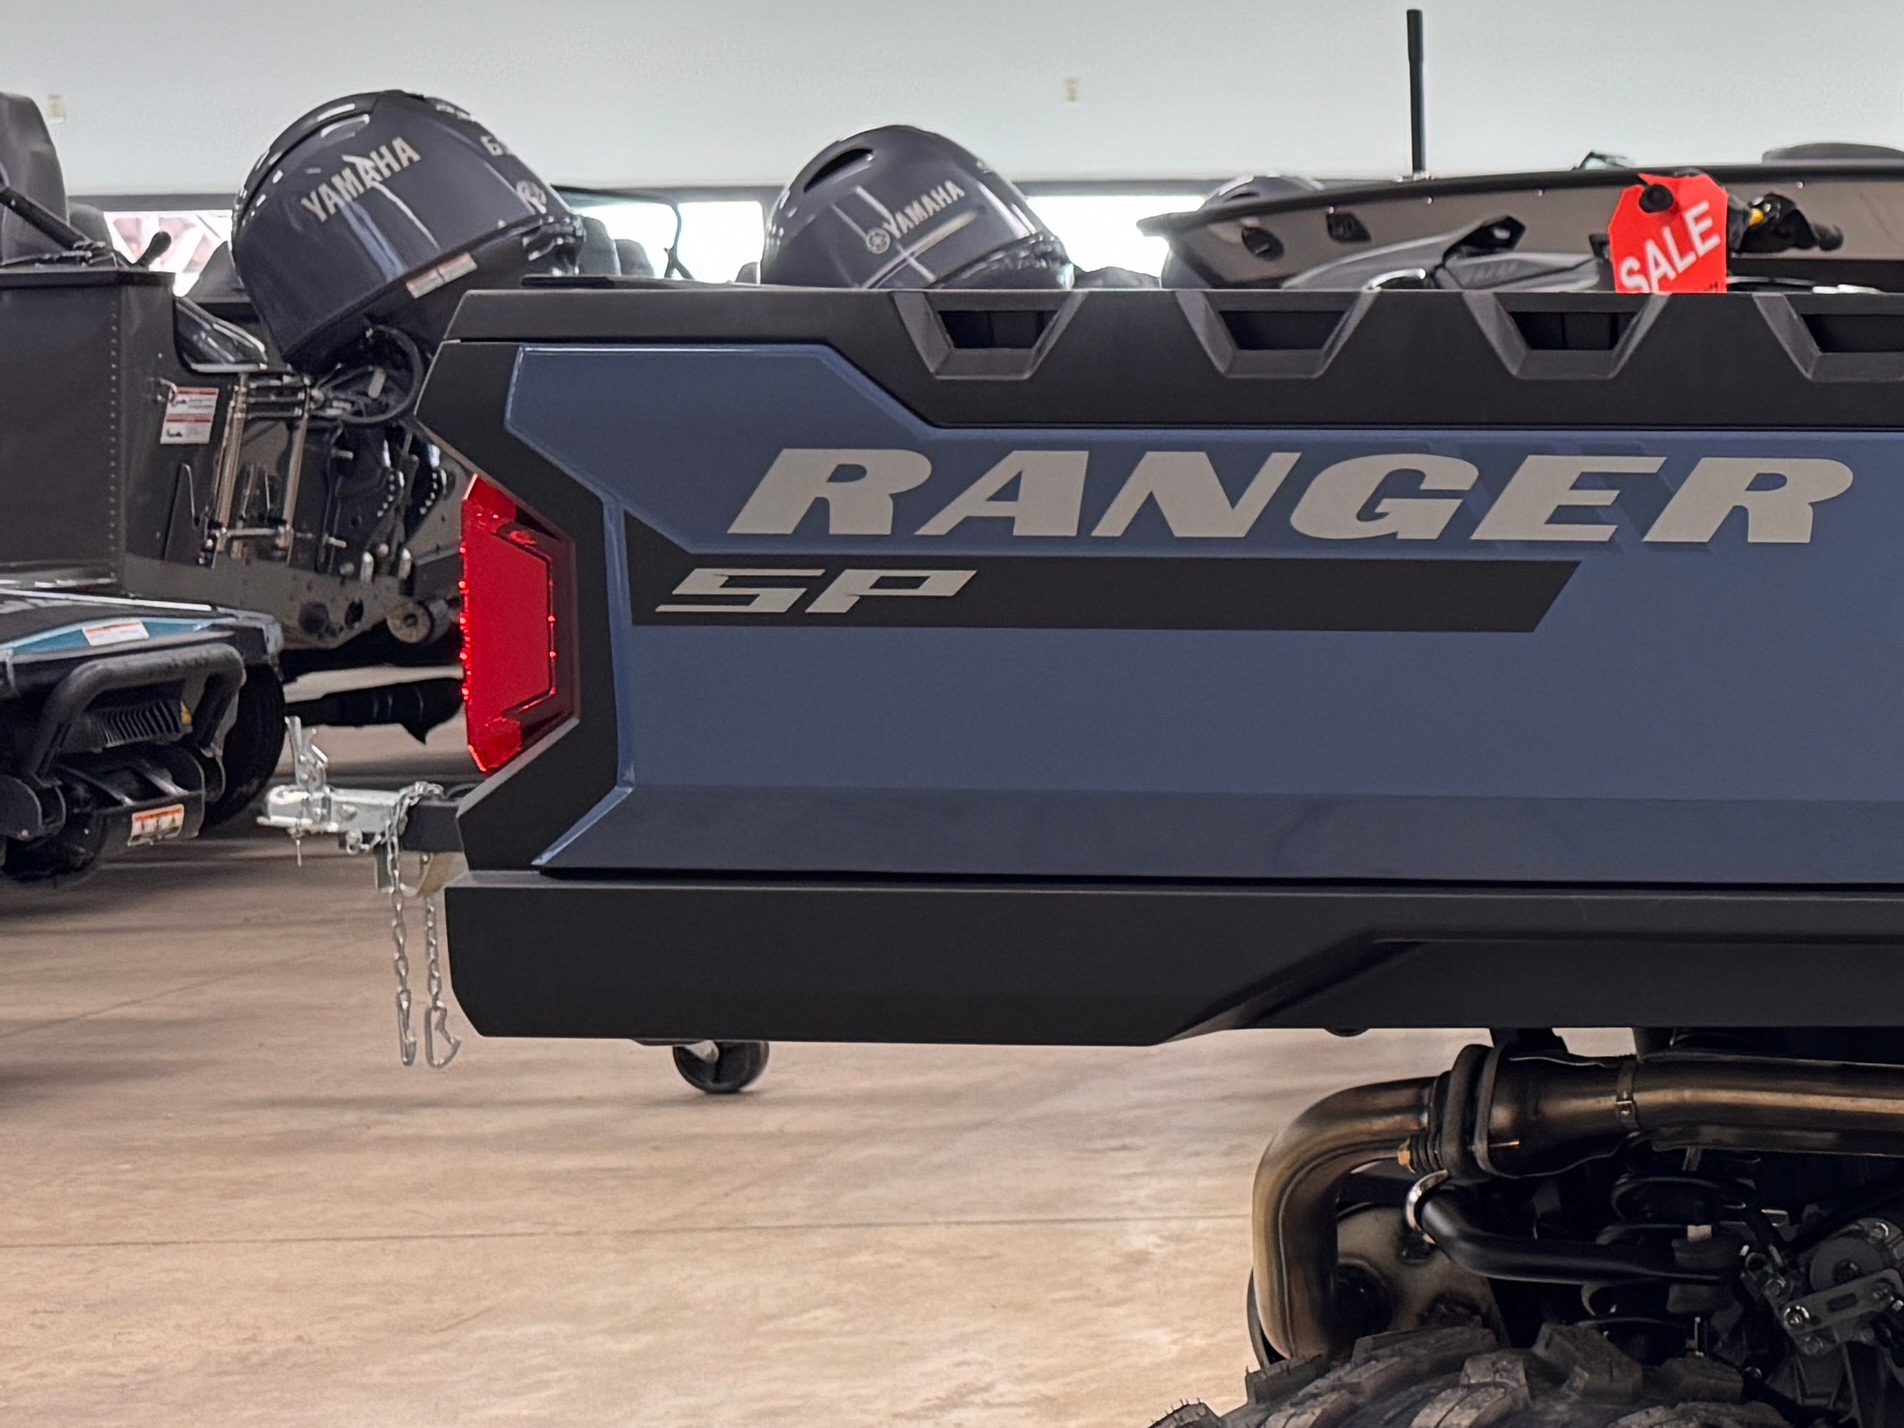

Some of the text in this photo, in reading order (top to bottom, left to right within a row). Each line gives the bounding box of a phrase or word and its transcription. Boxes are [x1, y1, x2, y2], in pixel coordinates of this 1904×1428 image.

[300, 135, 422, 224] YAMAHA
[881, 179, 967, 239] YAMAHA
[1620, 199, 1722, 293] SALE
[728, 448, 1854, 545] RANGER
[655, 568, 978, 614] SP
